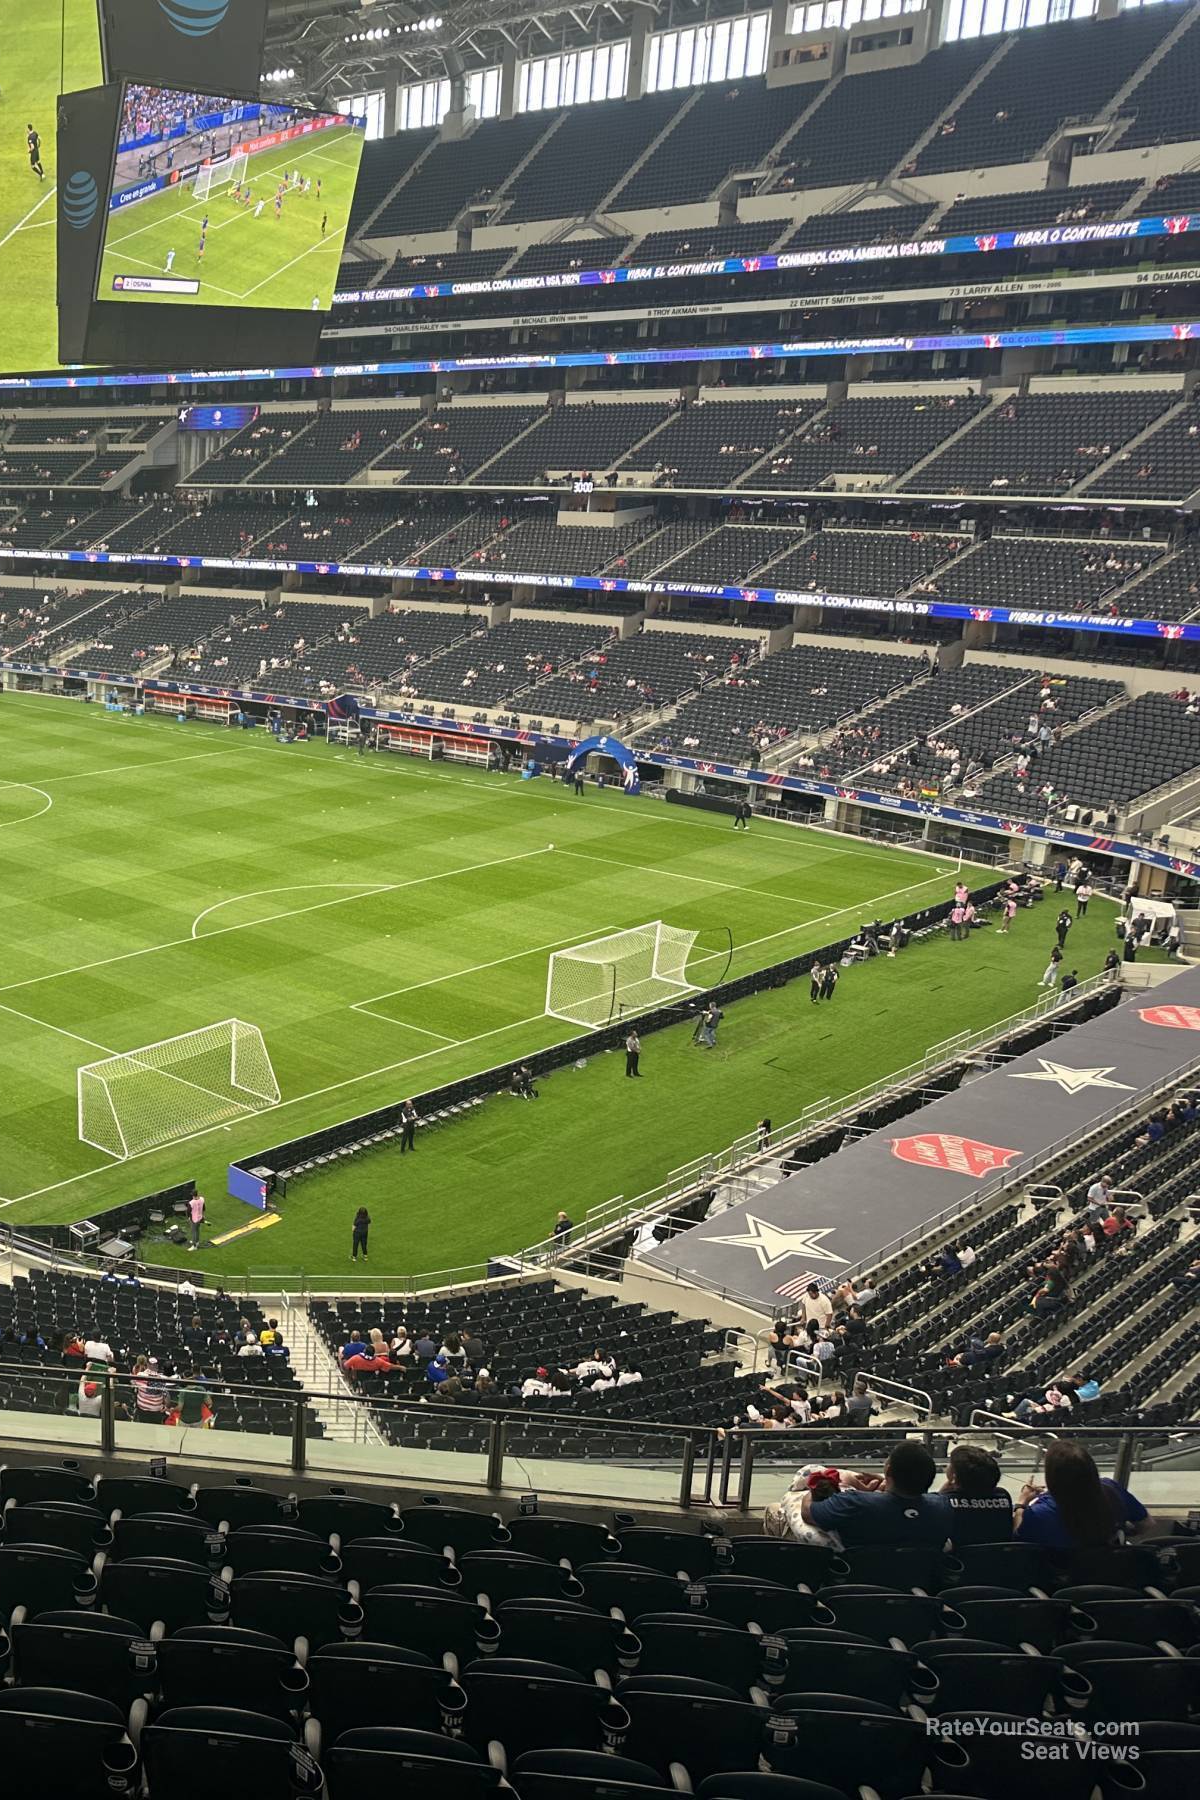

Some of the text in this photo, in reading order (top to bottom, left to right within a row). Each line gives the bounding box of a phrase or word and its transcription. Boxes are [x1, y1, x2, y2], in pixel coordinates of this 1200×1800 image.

[120, 183, 157, 203] Cree en grande
[1013, 221, 1141, 247] VIBRA O CONTINENTE
[777, 251, 828, 267] CONMEBOL
[899, 241, 920, 255] USA
[920, 239, 946, 254] 2024
[627, 261, 725, 281] VIBRA EL CONTINENTE
[451, 281, 492, 295] CONMEBOL
[545, 275, 561, 288] USA
[561, 274, 581, 285] 2024
[1137, 274, 1149, 283] 94
[361, 289, 375, 300] THE
[950, 287, 961, 296] 73
[963, 286, 992, 296] LARRY
[994, 283, 1023, 293] ALLEN
[790, 295, 856, 308] 22 EMMITT SMITH
[653, 309, 670, 317] TROY
[671, 307, 697, 316] AIKMAN
[521, 317, 549, 325] MICHAEL
[549, 315, 566, 324] IRVIN
[384, 326, 392, 334] 94
[392, 325, 420, 334] CHARLES
[420, 323, 439, 332] HALEY
[573, 482, 594, 493] 30:00
[337, 565, 420, 578] ROCKING THE CONTINENT
[455, 571, 495, 583] CONMEBOL
[547, 576, 562, 587] USA
[626, 581, 652, 593] VIBRA
[653, 583, 666, 593] EL
[774, 592, 826, 608] CONMEBOL
[896, 601, 915, 614] USA
[1008, 610, 1044, 624] VIBRA
[1045, 612, 1055, 625] O
